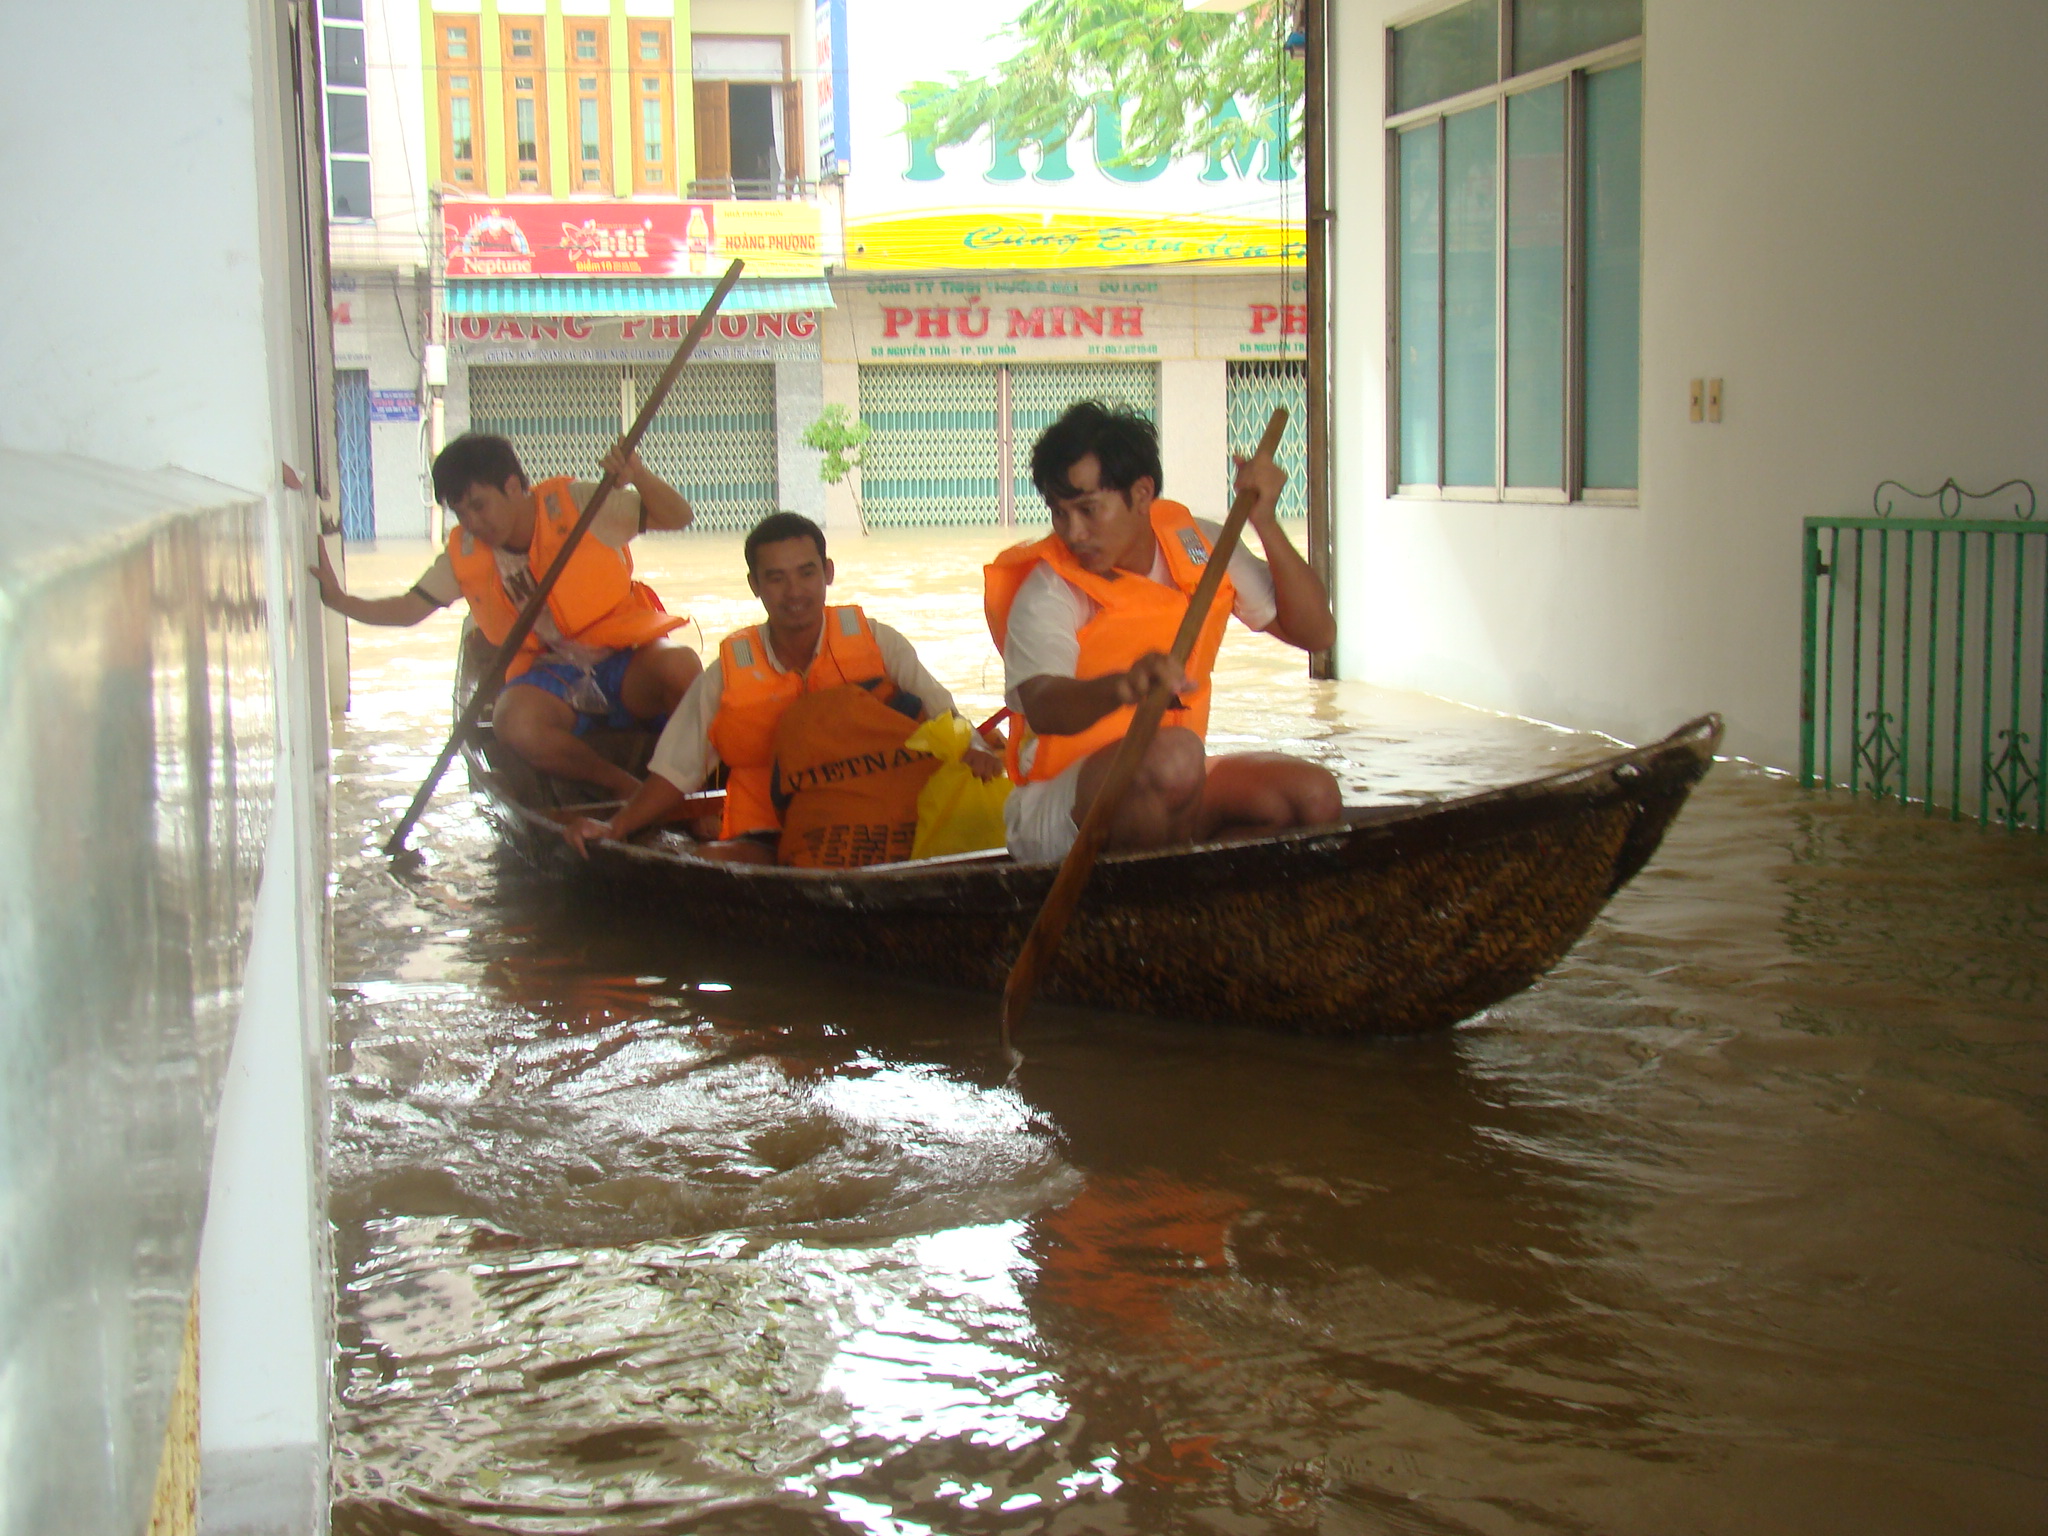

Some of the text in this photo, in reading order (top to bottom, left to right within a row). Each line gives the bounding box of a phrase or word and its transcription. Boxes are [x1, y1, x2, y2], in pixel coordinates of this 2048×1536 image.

[463, 257, 531, 274] Neptune
[914, 281, 935, 294] TY
[1006, 306, 1143, 338] MINH
[787, 748, 933, 792] VIETNA
